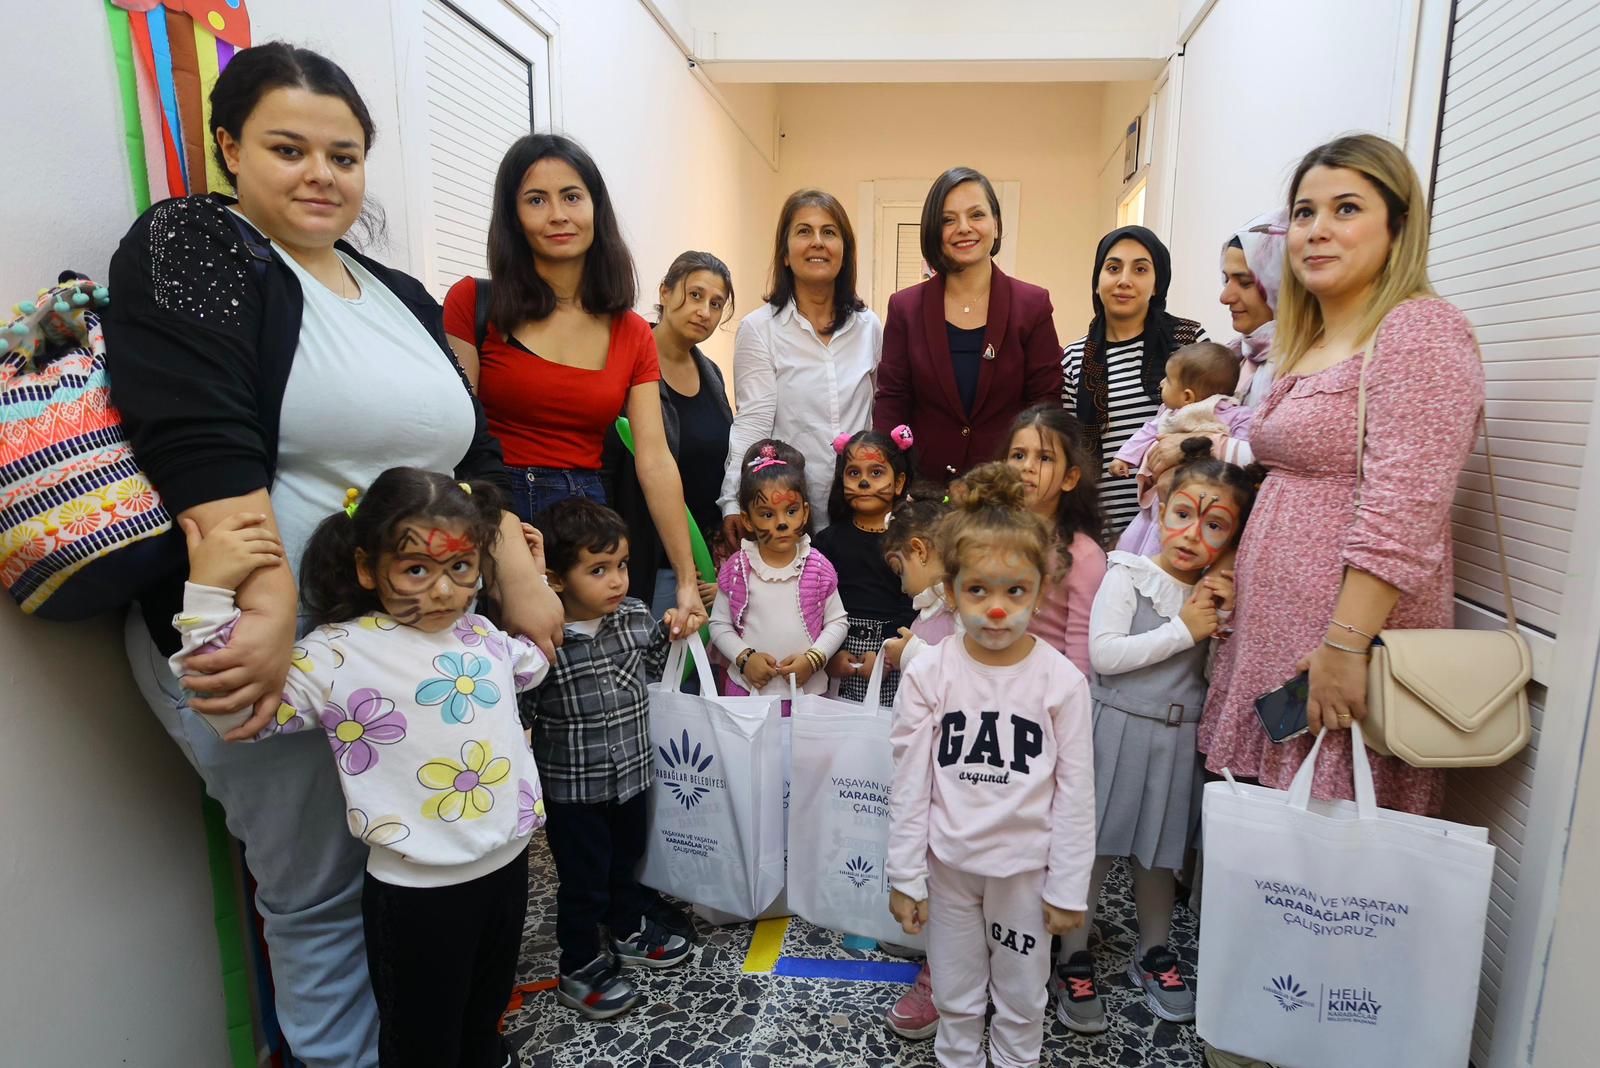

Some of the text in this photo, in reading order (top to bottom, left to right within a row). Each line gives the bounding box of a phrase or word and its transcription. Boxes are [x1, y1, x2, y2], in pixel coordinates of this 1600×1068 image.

[937, 710, 1043, 775] GAP
[656, 768, 688, 782] RABAĞLAR
[832, 777, 892, 794] YAŞAYAN VE
[839, 789, 889, 805] KARABAĞ
[853, 803, 890, 818] ÇALIŞIY
[661, 829, 685, 839] YAŞAYAN
[694, 835, 718, 845] YAŞATAN
[666, 837, 702, 849] KARABAĞLAR
[1254, 879, 1409, 915] YAŞAYAN VE YAŞATAN
[1264, 894, 1396, 927] KARABAĞLAR İÇİN
[1283, 912, 1377, 938] ÇALIŞIYORUZ.
[991, 922, 1036, 956] GAP
[1329, 987, 1378, 1003] HELİL
[1328, 1000, 1382, 1015] KINAY
